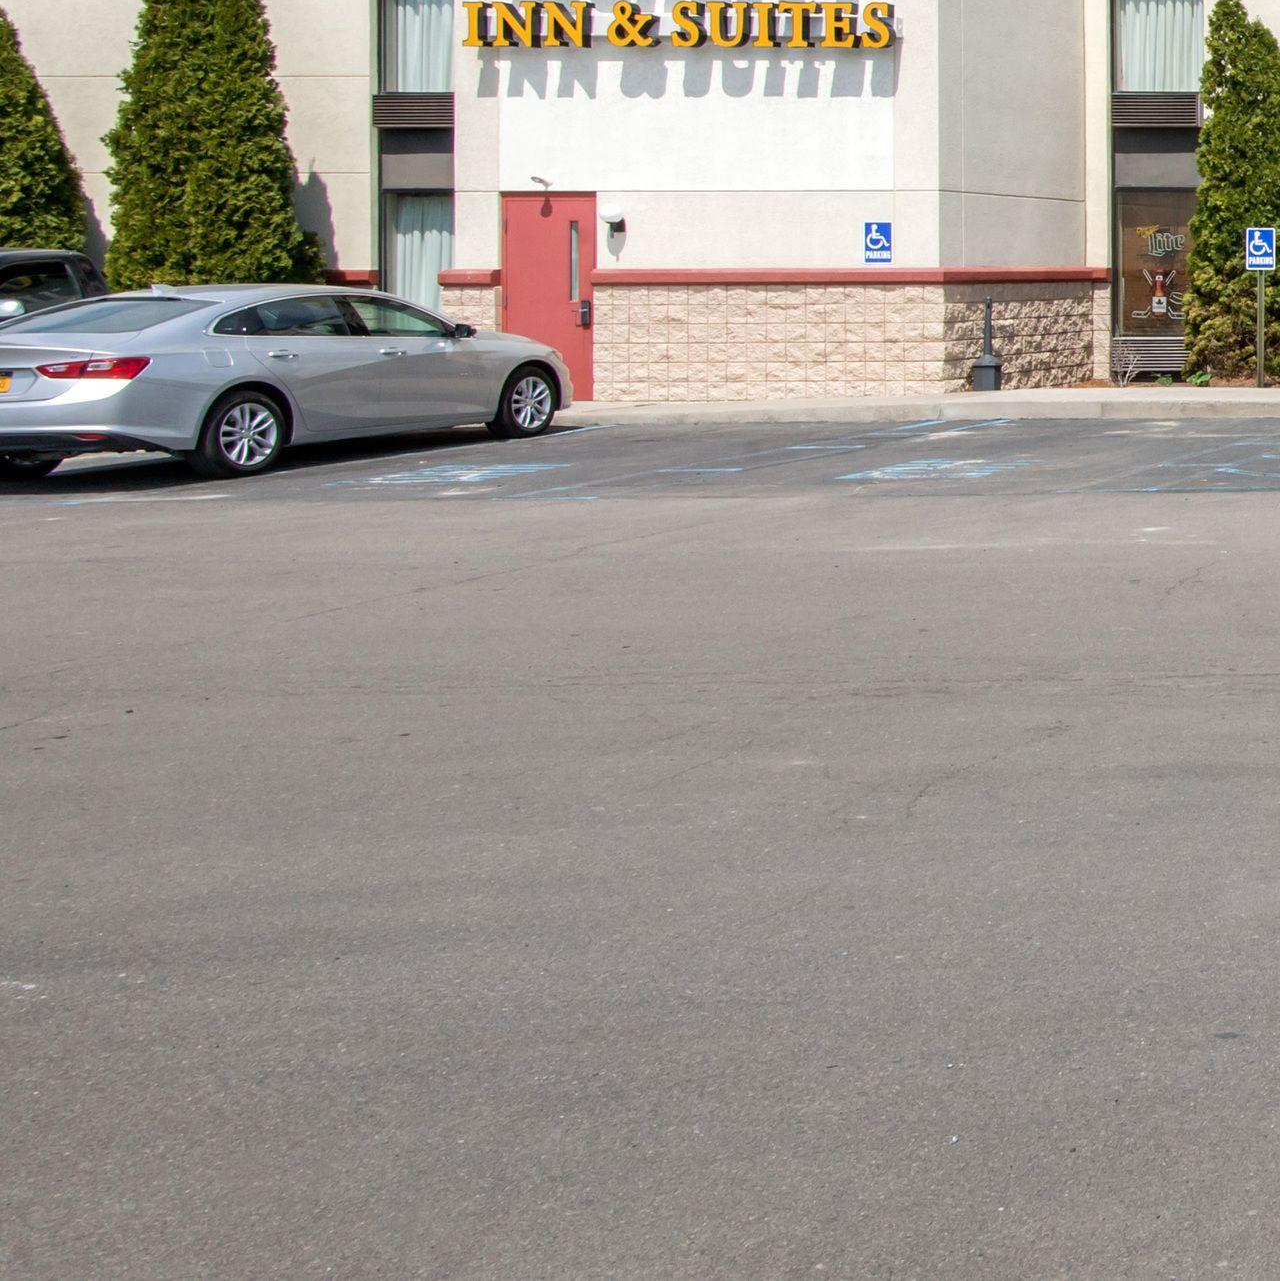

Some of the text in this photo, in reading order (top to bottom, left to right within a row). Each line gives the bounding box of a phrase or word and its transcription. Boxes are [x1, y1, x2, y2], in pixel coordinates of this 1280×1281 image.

[462, 0, 896, 49] INN & SUITES
[865, 250, 892, 259] PARKING
[1248, 256, 1274, 265] PARKING
